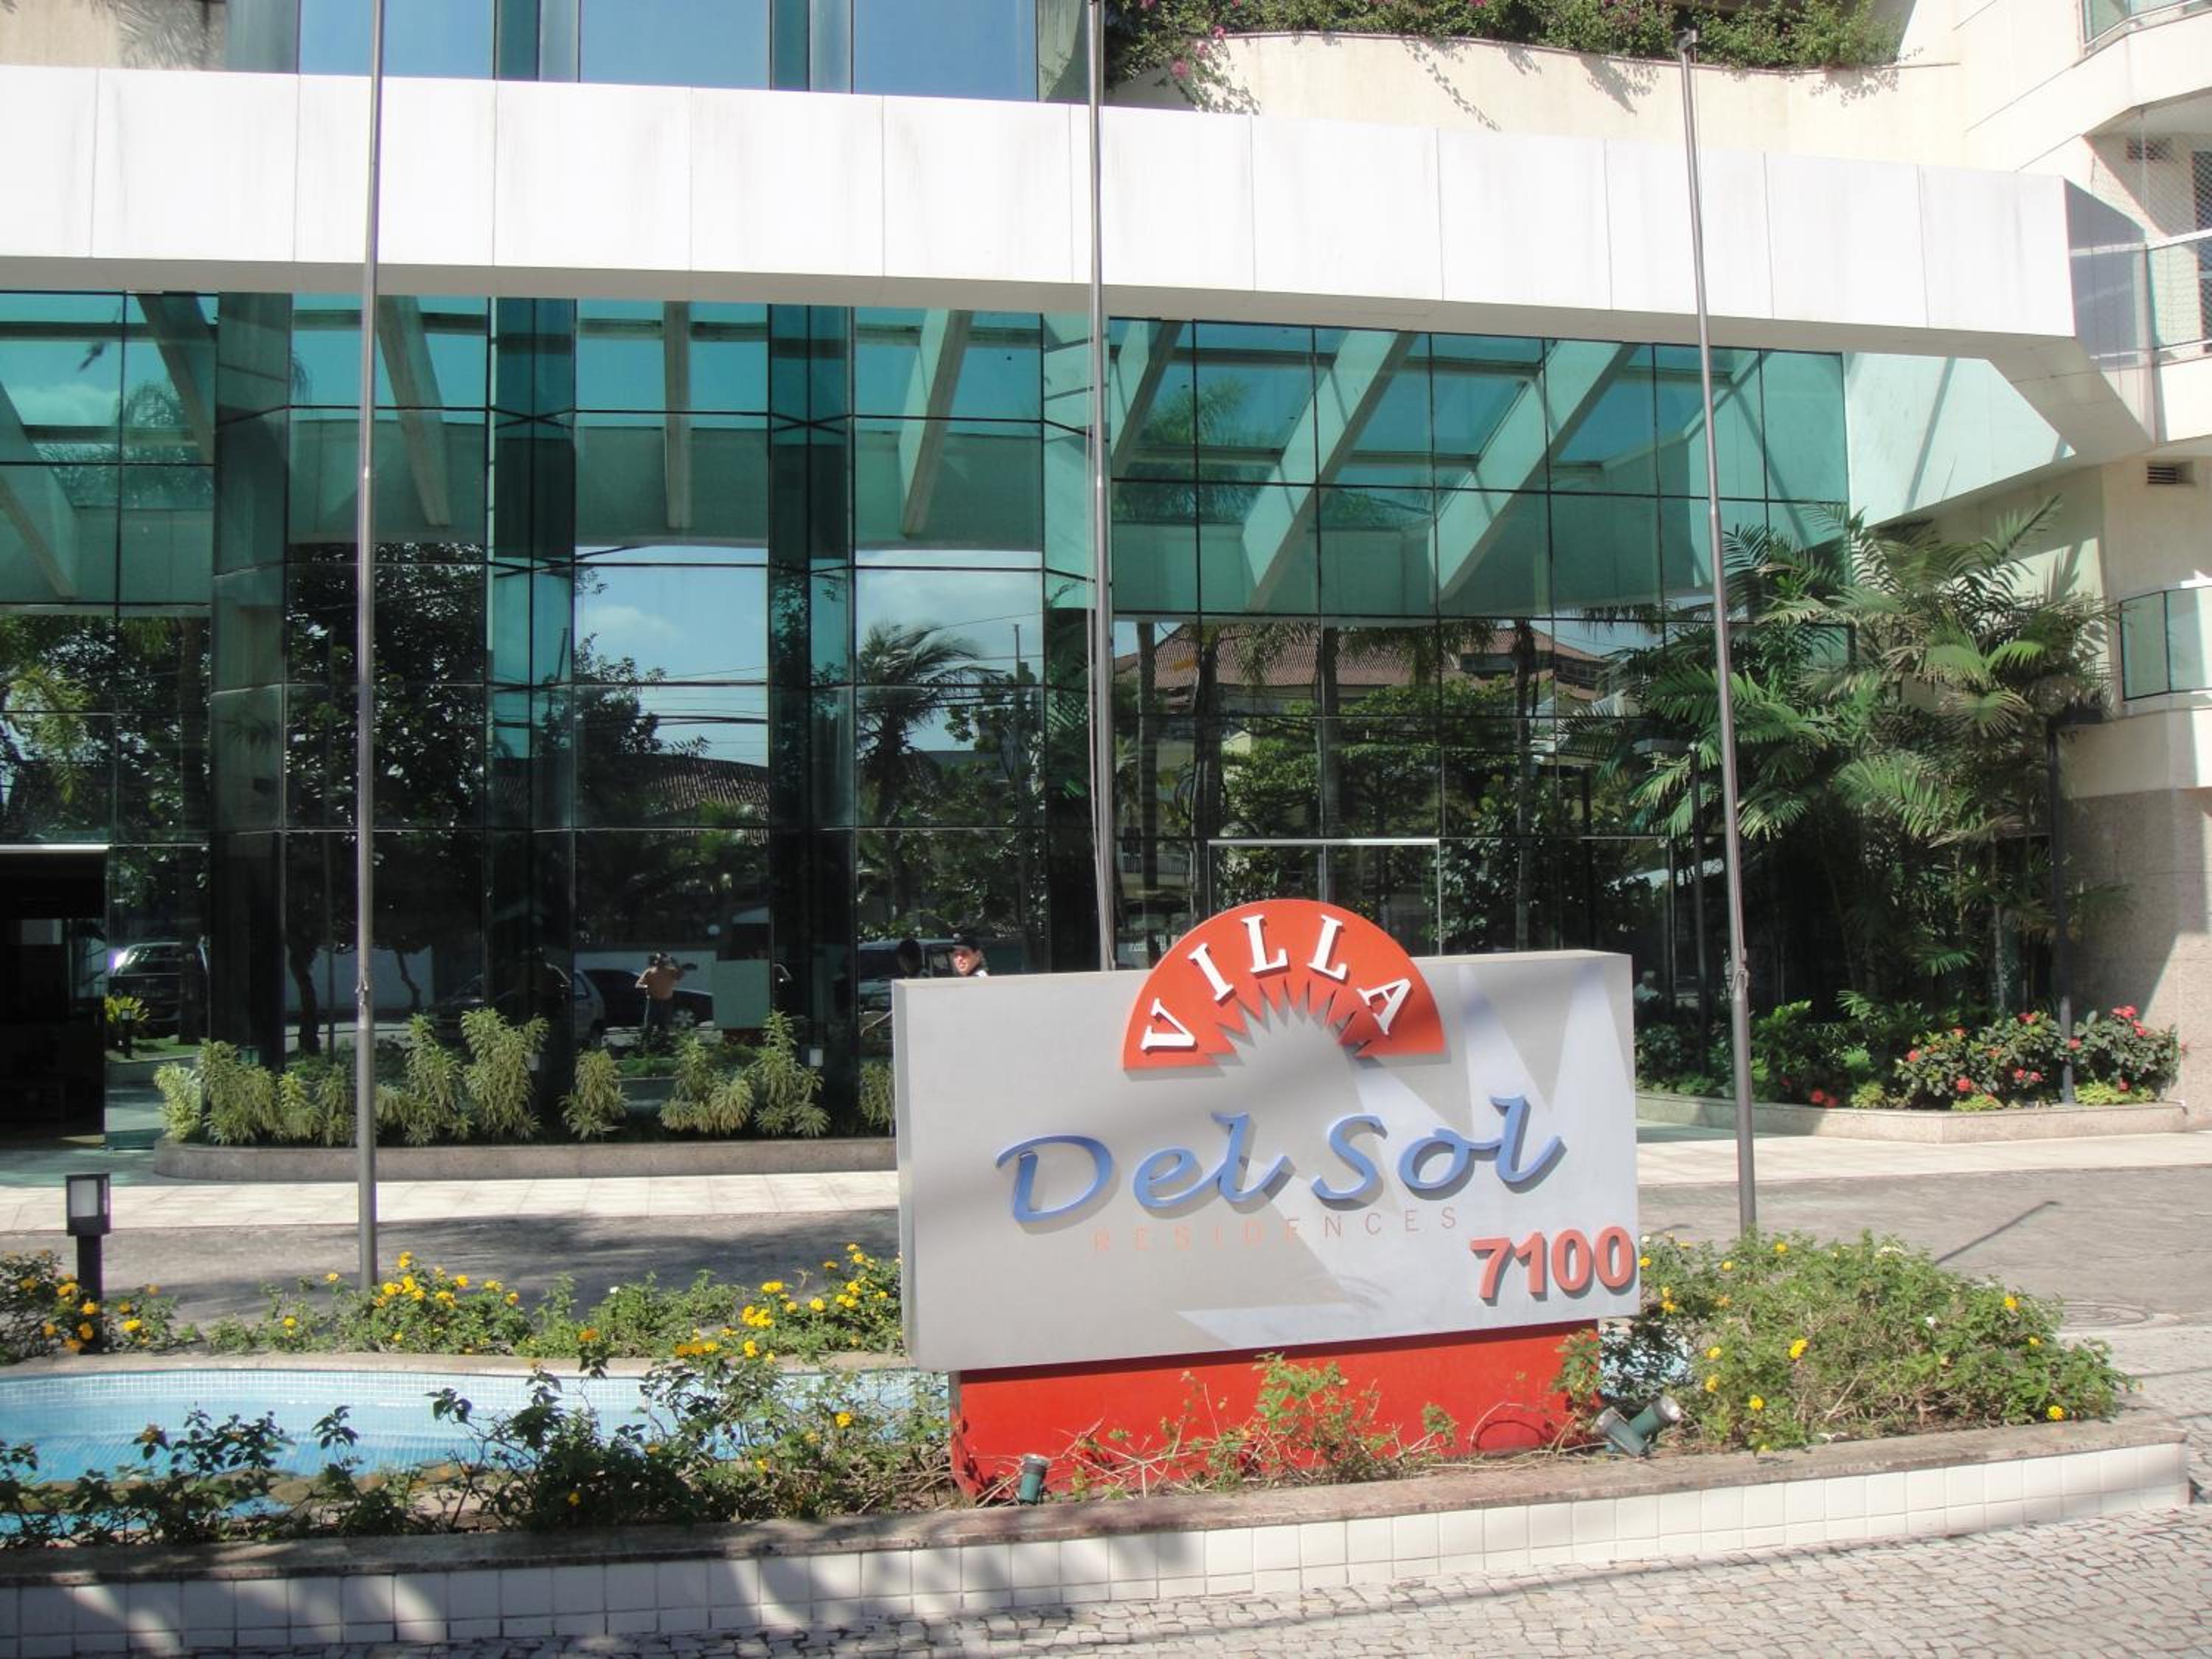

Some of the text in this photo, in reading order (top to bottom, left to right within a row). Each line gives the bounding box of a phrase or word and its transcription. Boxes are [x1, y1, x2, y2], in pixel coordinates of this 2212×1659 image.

[1140, 914, 1411, 1051] VILLA
[995, 1095, 1568, 1223] Del Sol
[1094, 1206, 1458, 1251] RESIDENCES
[1470, 1226, 1635, 1298] 7100
